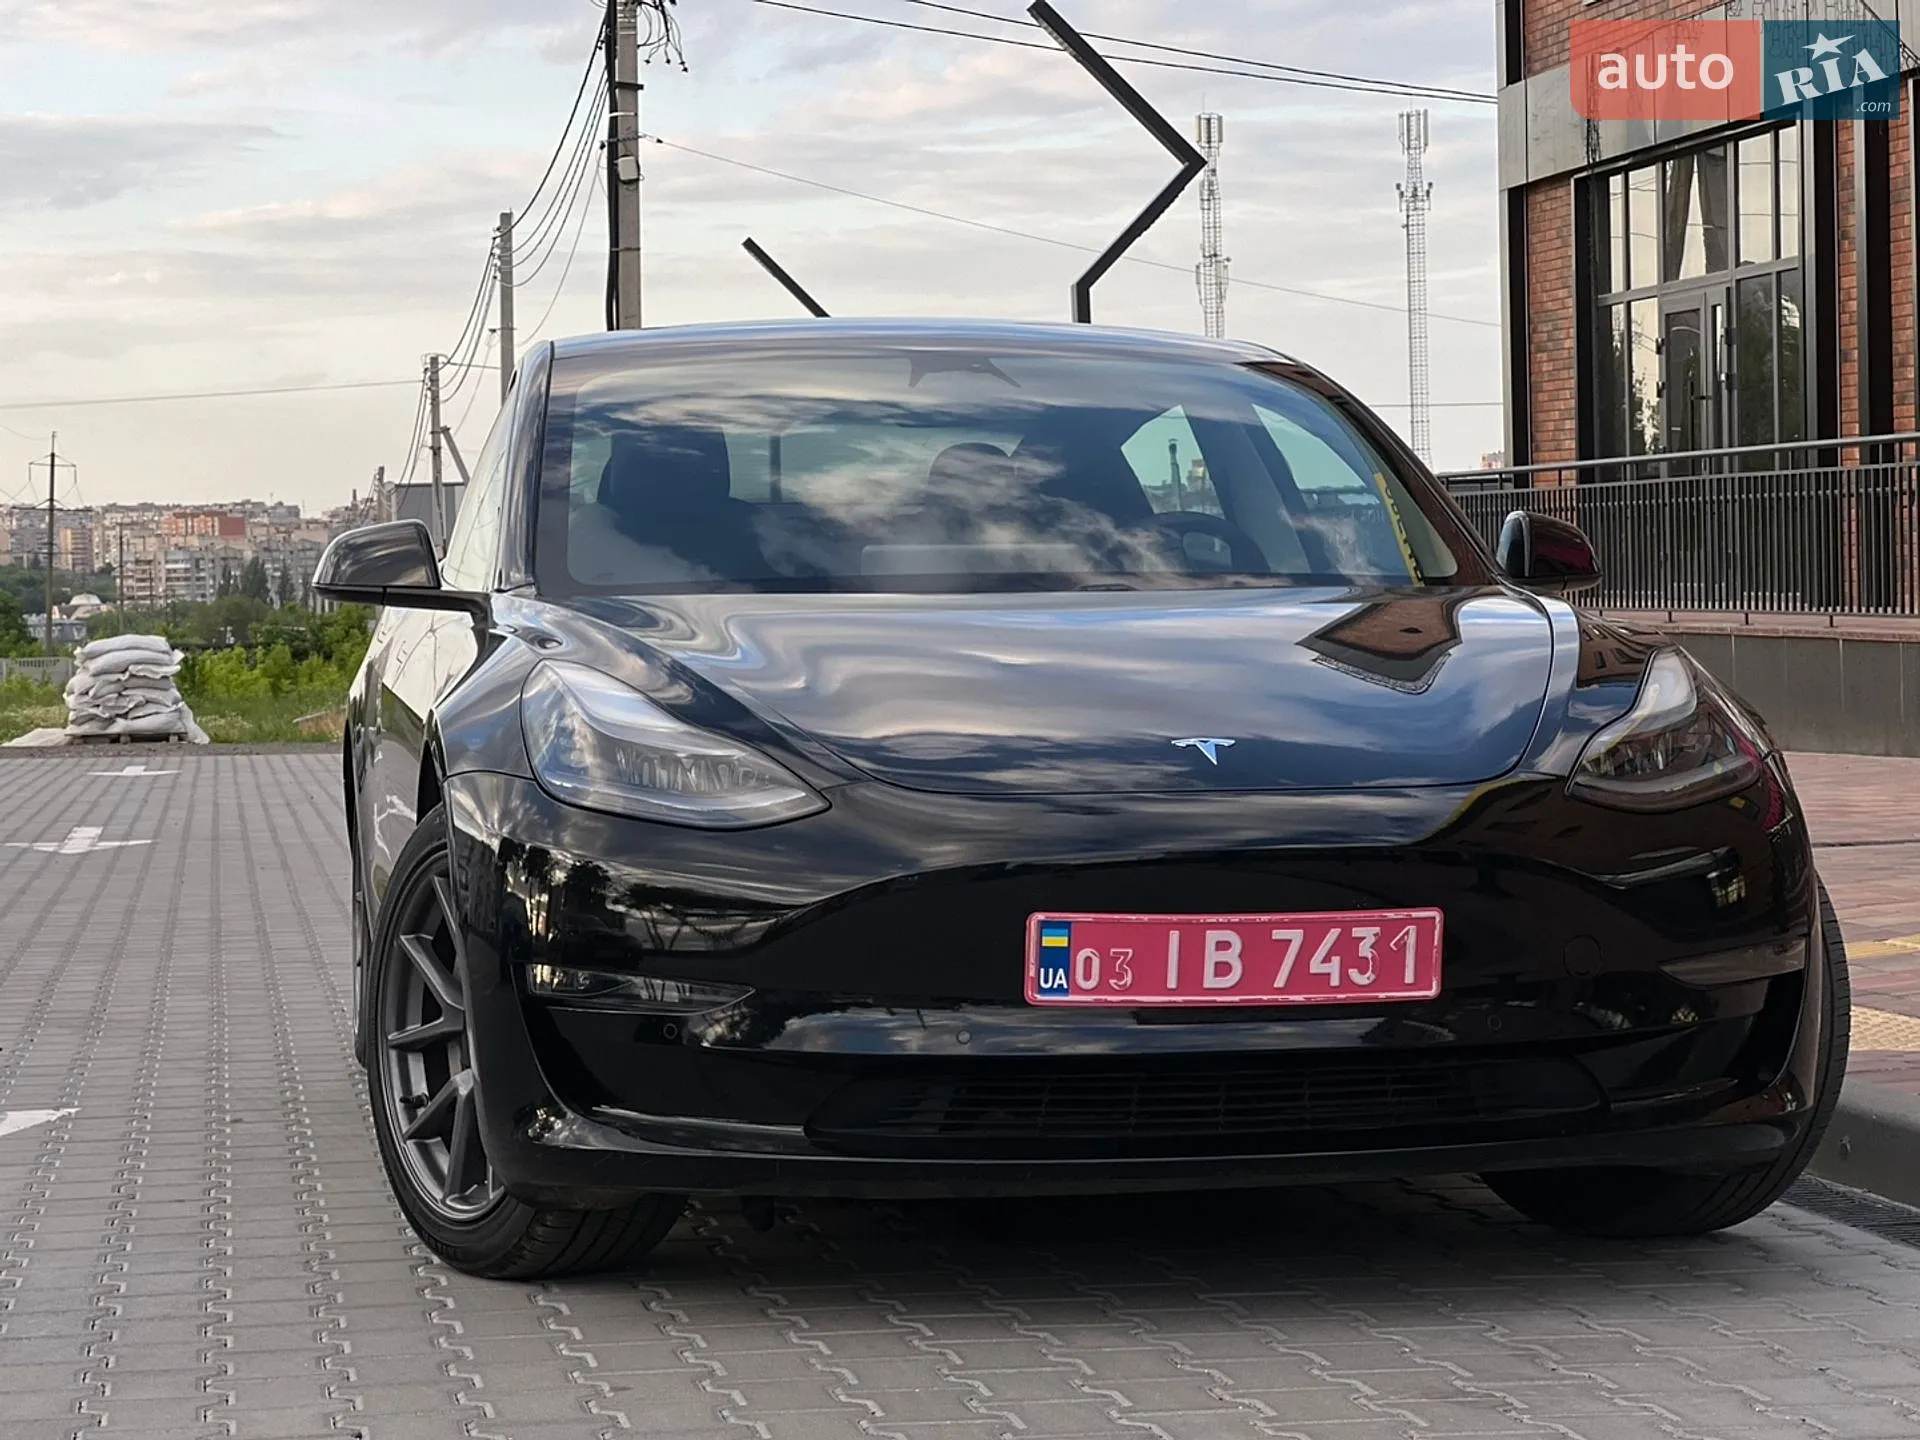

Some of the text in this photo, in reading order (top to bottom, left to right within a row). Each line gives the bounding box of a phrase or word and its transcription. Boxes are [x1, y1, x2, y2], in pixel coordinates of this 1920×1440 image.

[1039, 967, 1068, 989] UA
[1074, 948, 1134, 991] 03
[1271, 925, 1418, 989] 7431
